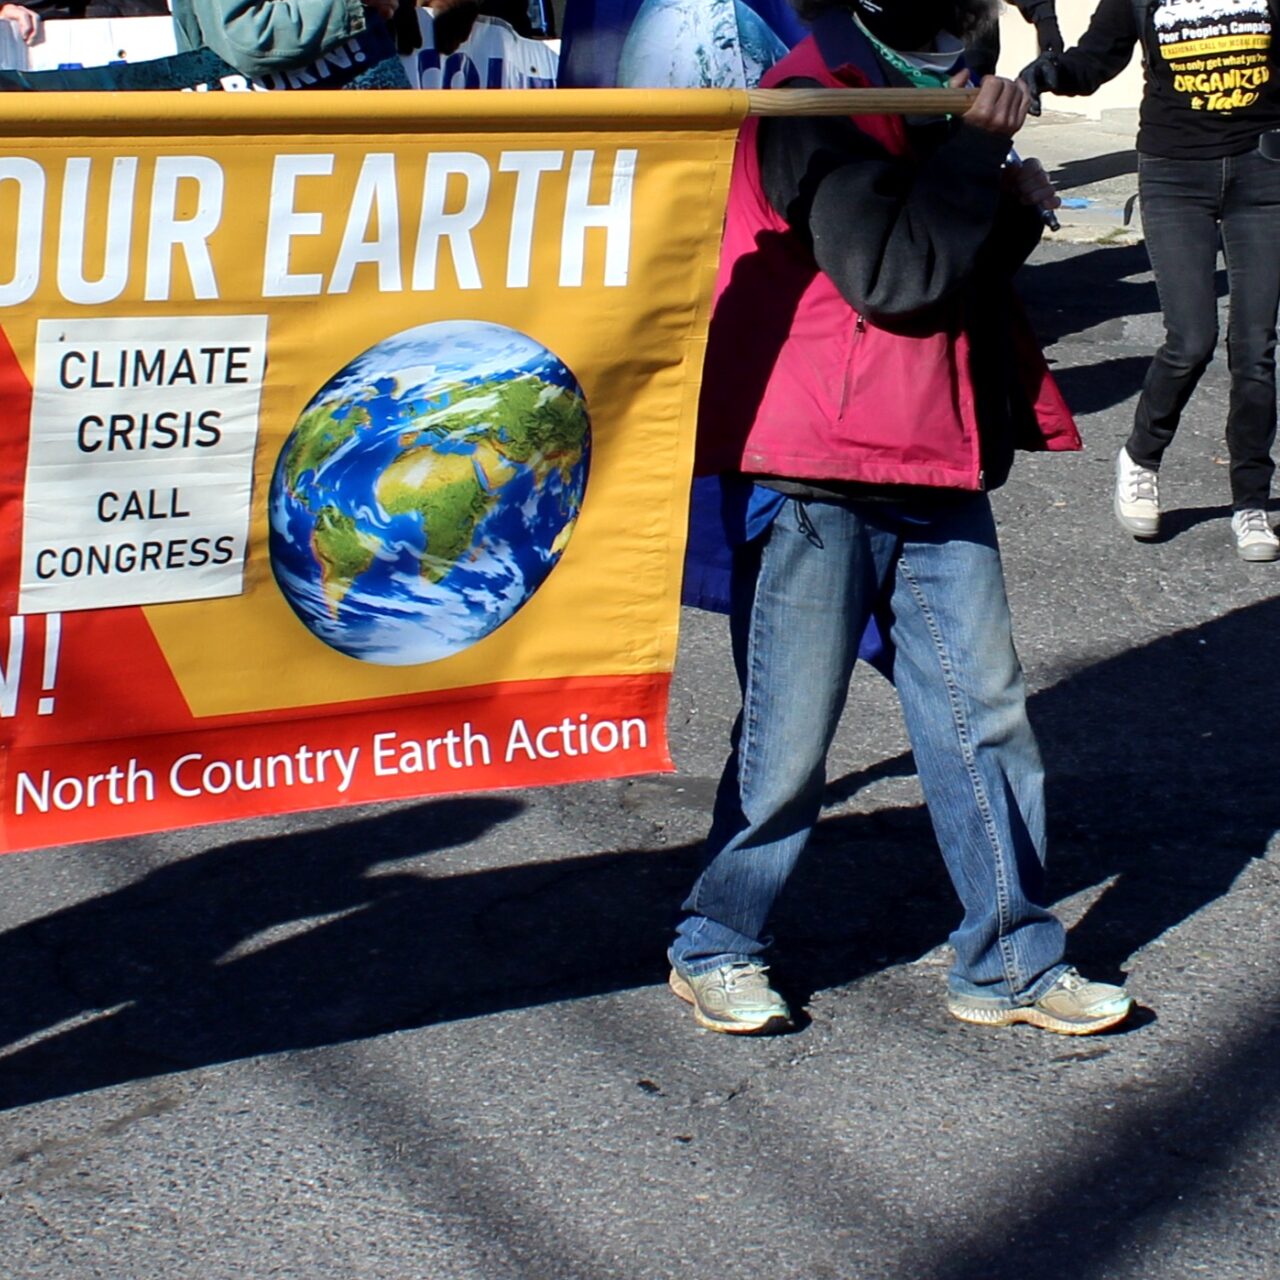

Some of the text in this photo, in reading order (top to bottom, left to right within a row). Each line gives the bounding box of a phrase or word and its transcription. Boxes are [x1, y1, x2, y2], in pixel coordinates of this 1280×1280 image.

[1158, 32, 1180, 44] Poor
[1181, 23, 1228, 41] People's
[1169, 61, 1186, 72] You
[1187, 60, 1205, 72] only
[1206, 57, 1222, 71] get
[1223, 55, 1245, 66] what
[1174, 66, 1269, 93] ORGANIZED
[1204, 89, 1259, 111] Take
[262, 148, 639, 298] EARTH
[60, 347, 251, 390] CLIMATE
[77, 411, 222, 453] CRISIS
[97, 487, 190, 522] CALL
[36, 535, 234, 580] CONGRESS
[14, 712, 648, 814] North Country Earth Action
